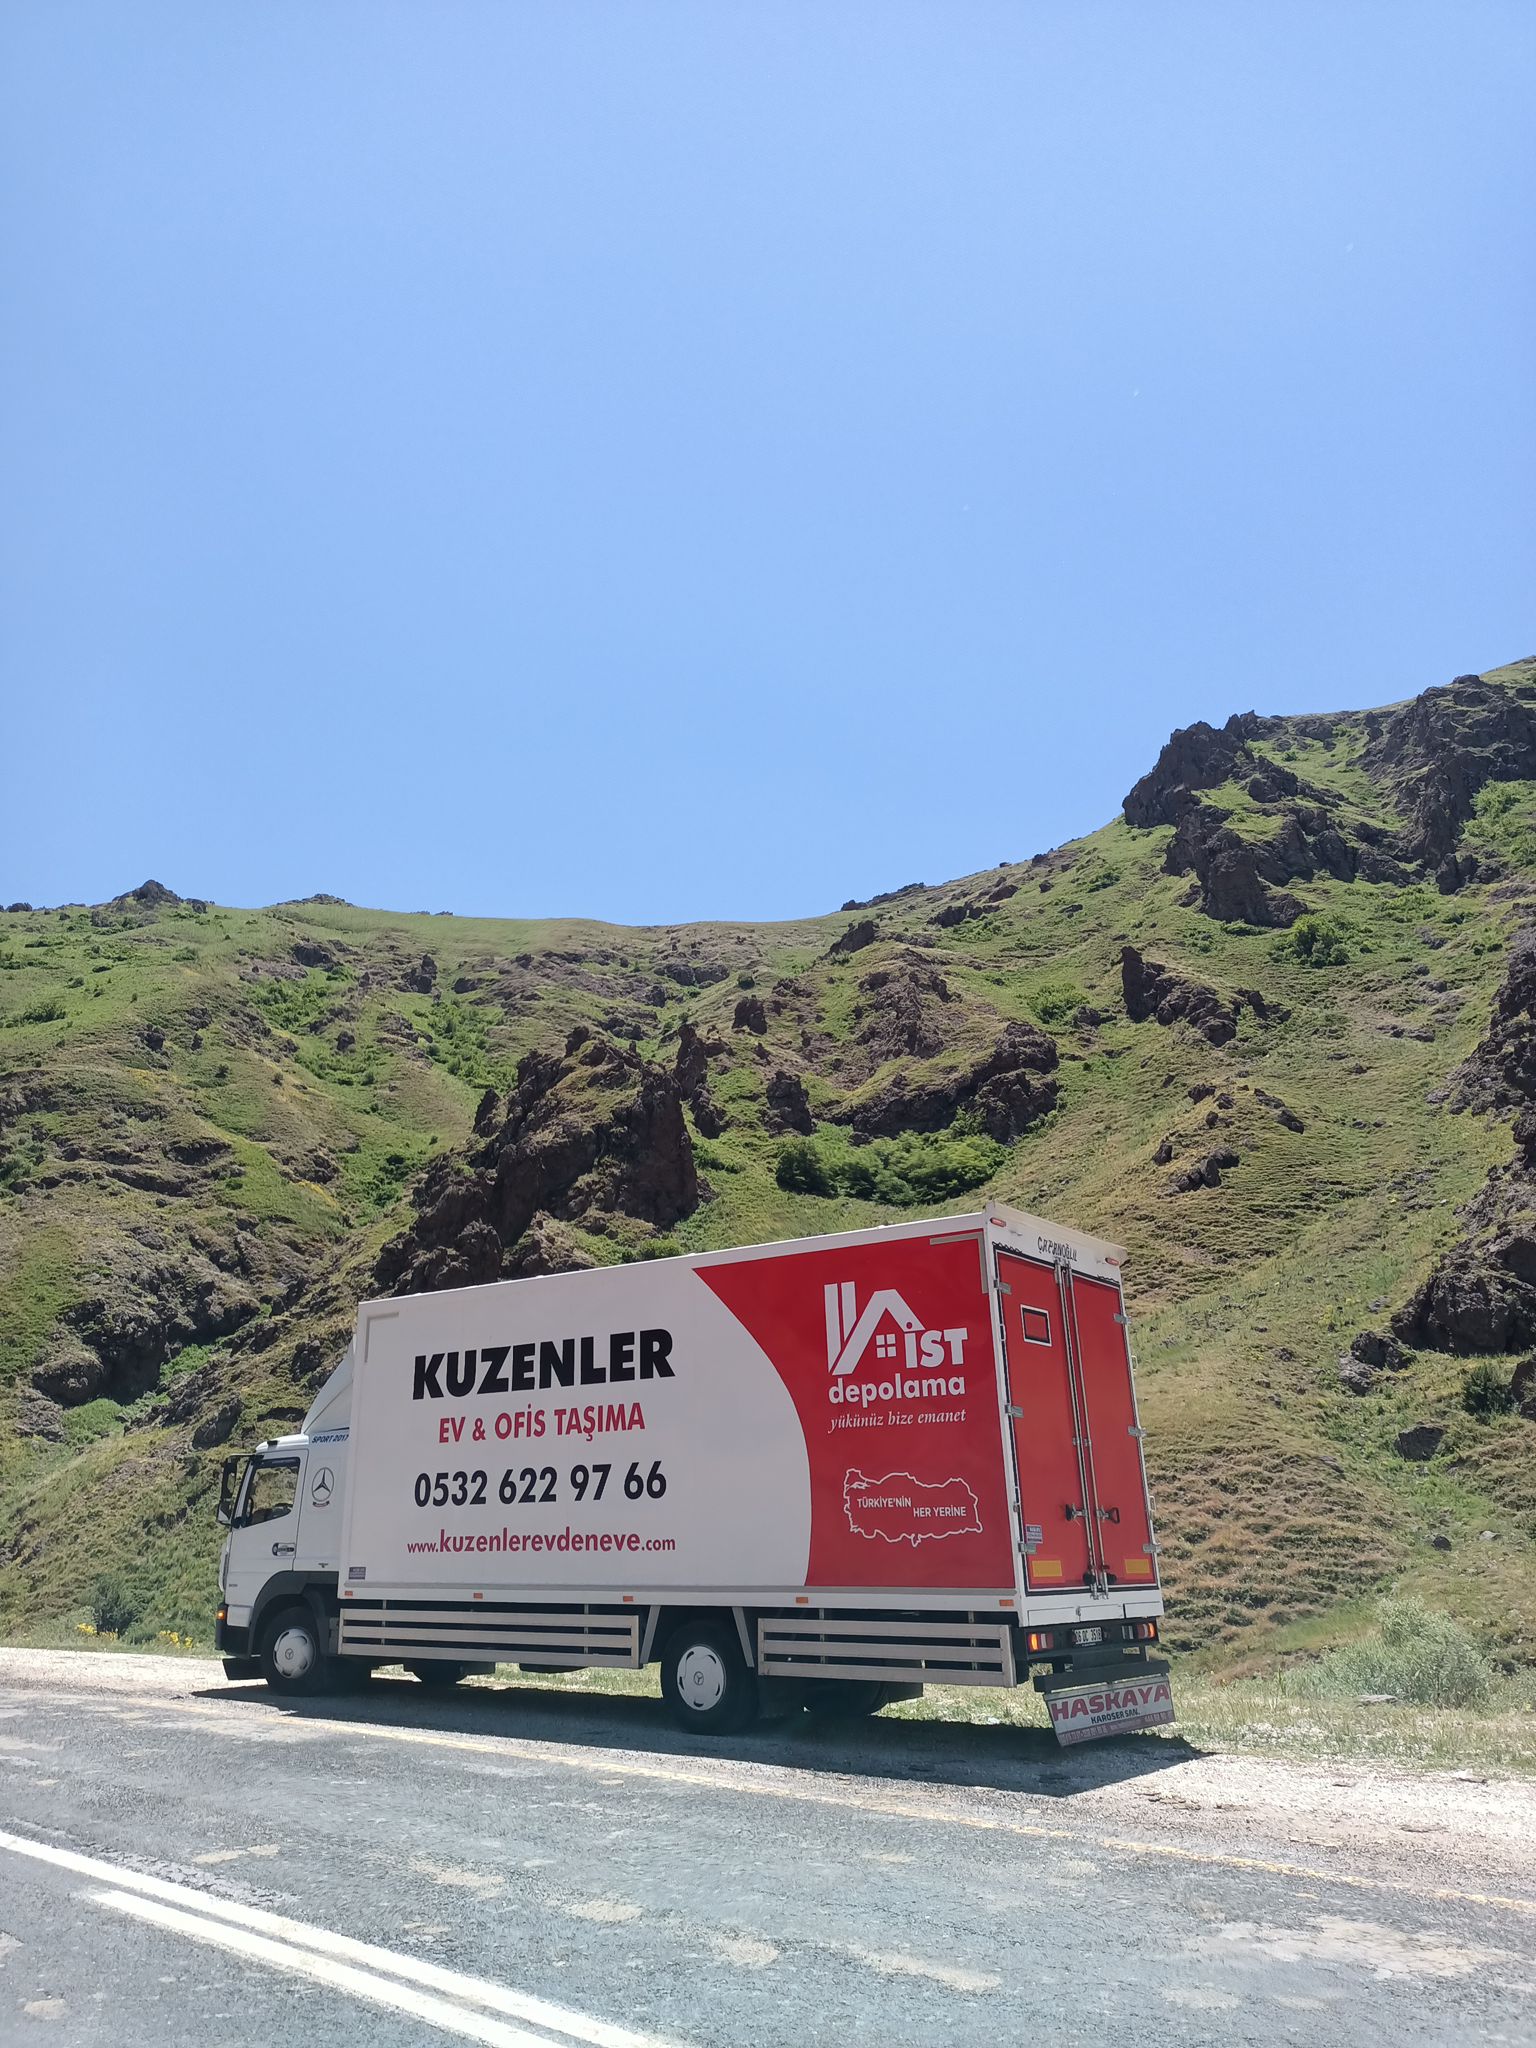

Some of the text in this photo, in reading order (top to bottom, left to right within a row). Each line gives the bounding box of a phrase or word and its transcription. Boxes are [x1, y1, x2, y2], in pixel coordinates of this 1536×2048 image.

[412, 1328, 675, 1400] KUZENLER
[828, 1373, 966, 1408] depolama
[439, 1402, 645, 1443] EV & OFİS TAŞIMA
[828, 1409, 966, 1434] yükünüz bize emanet
[414, 1460, 667, 1507] 0532 622 97 66
[913, 1505, 966, 1517] HER YERİNE
[407, 1526, 676, 1553] www.kuzenlerevdeneve.com
[1051, 1684, 1170, 1721] HASKAYA
[1091, 1711, 1125, 1724] KAROSER
